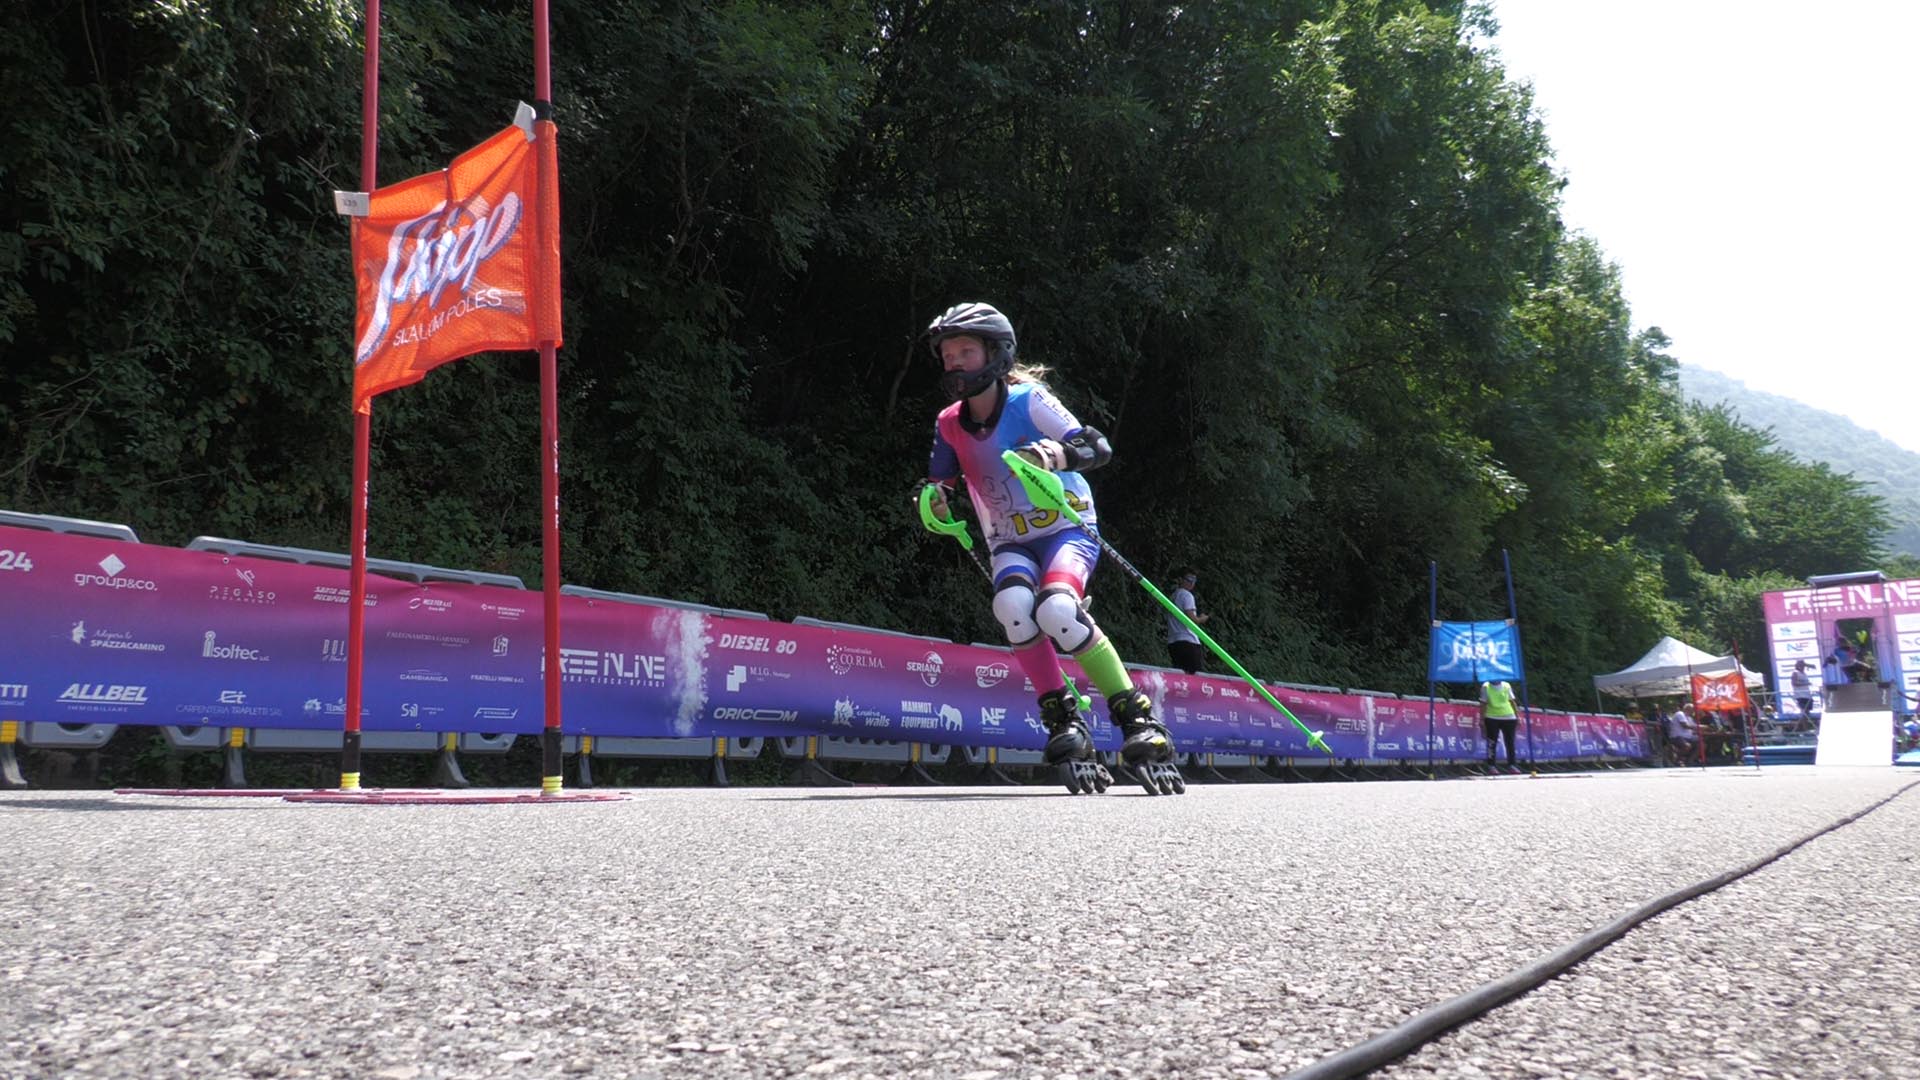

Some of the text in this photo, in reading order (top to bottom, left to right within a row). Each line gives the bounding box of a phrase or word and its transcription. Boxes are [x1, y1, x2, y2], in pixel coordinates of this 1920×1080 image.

[446, 288, 502, 324] POLES
[0, 550, 33, 571] 24
[75, 574, 158, 591] group&co.
[90, 639, 165, 652] SPAZZACAMINO
[719, 634, 797, 654] DIESEL 80
[906, 661, 942, 674] SERIANA
[989, 668, 1009, 678] LVF
[60, 683, 148, 702] ALLBEL
[67, 705, 129, 713] IMMOBILIARE
[713, 707, 798, 722] ORICOM
[865, 715, 891, 728] walls
[901, 716, 939, 729] EQUIPMENT
